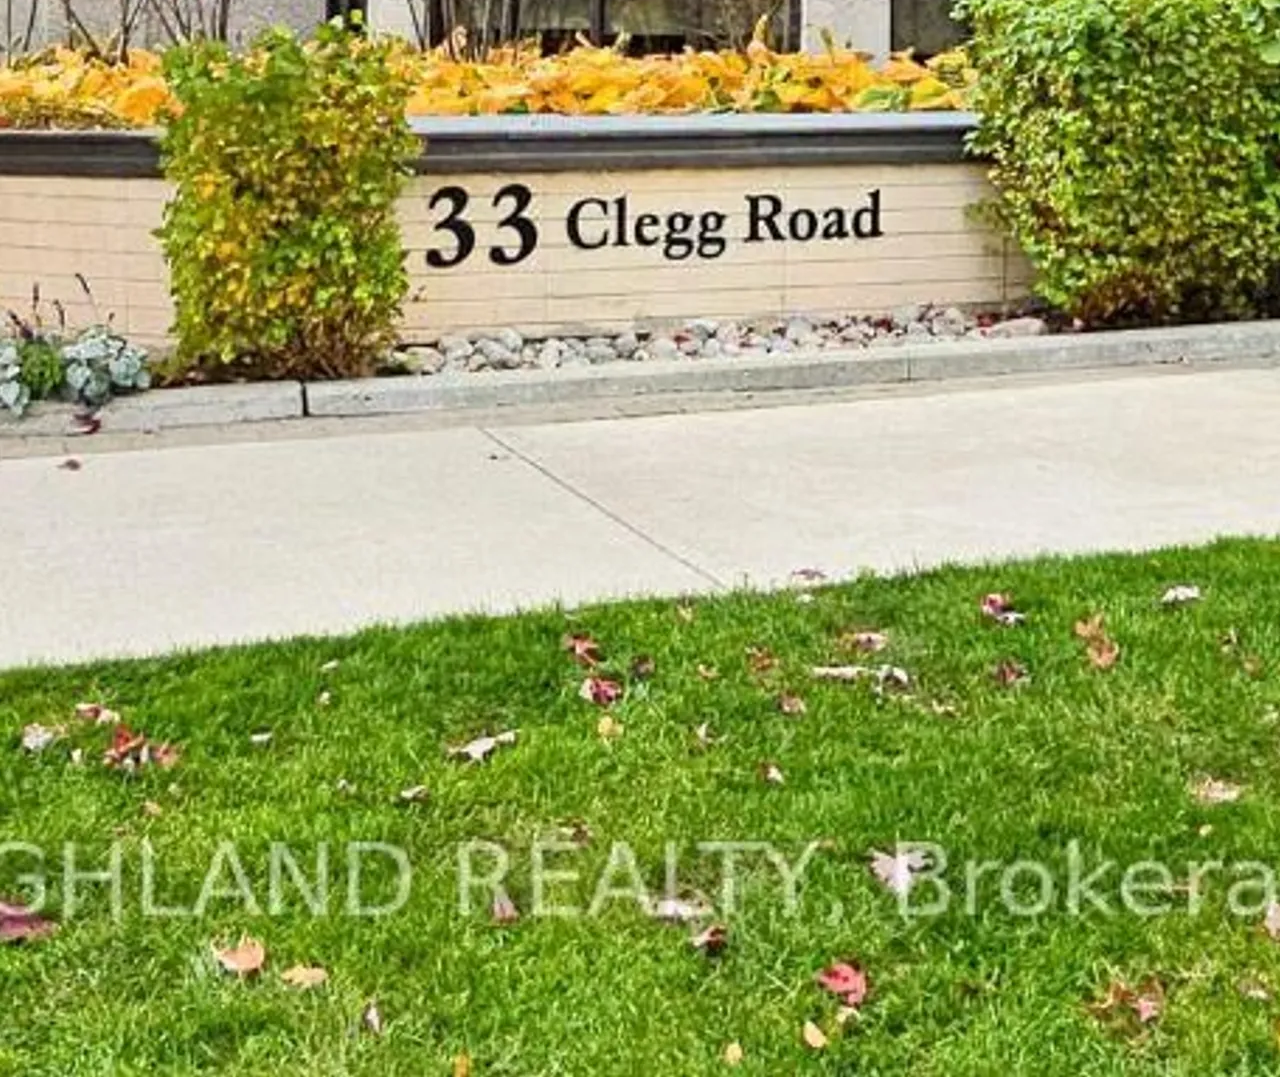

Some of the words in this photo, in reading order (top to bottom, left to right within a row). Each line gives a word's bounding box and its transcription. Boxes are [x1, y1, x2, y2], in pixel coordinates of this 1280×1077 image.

[426, 183, 538, 269] 33
[565, 195, 727, 260] Clegg
[743, 189, 884, 243] Road
